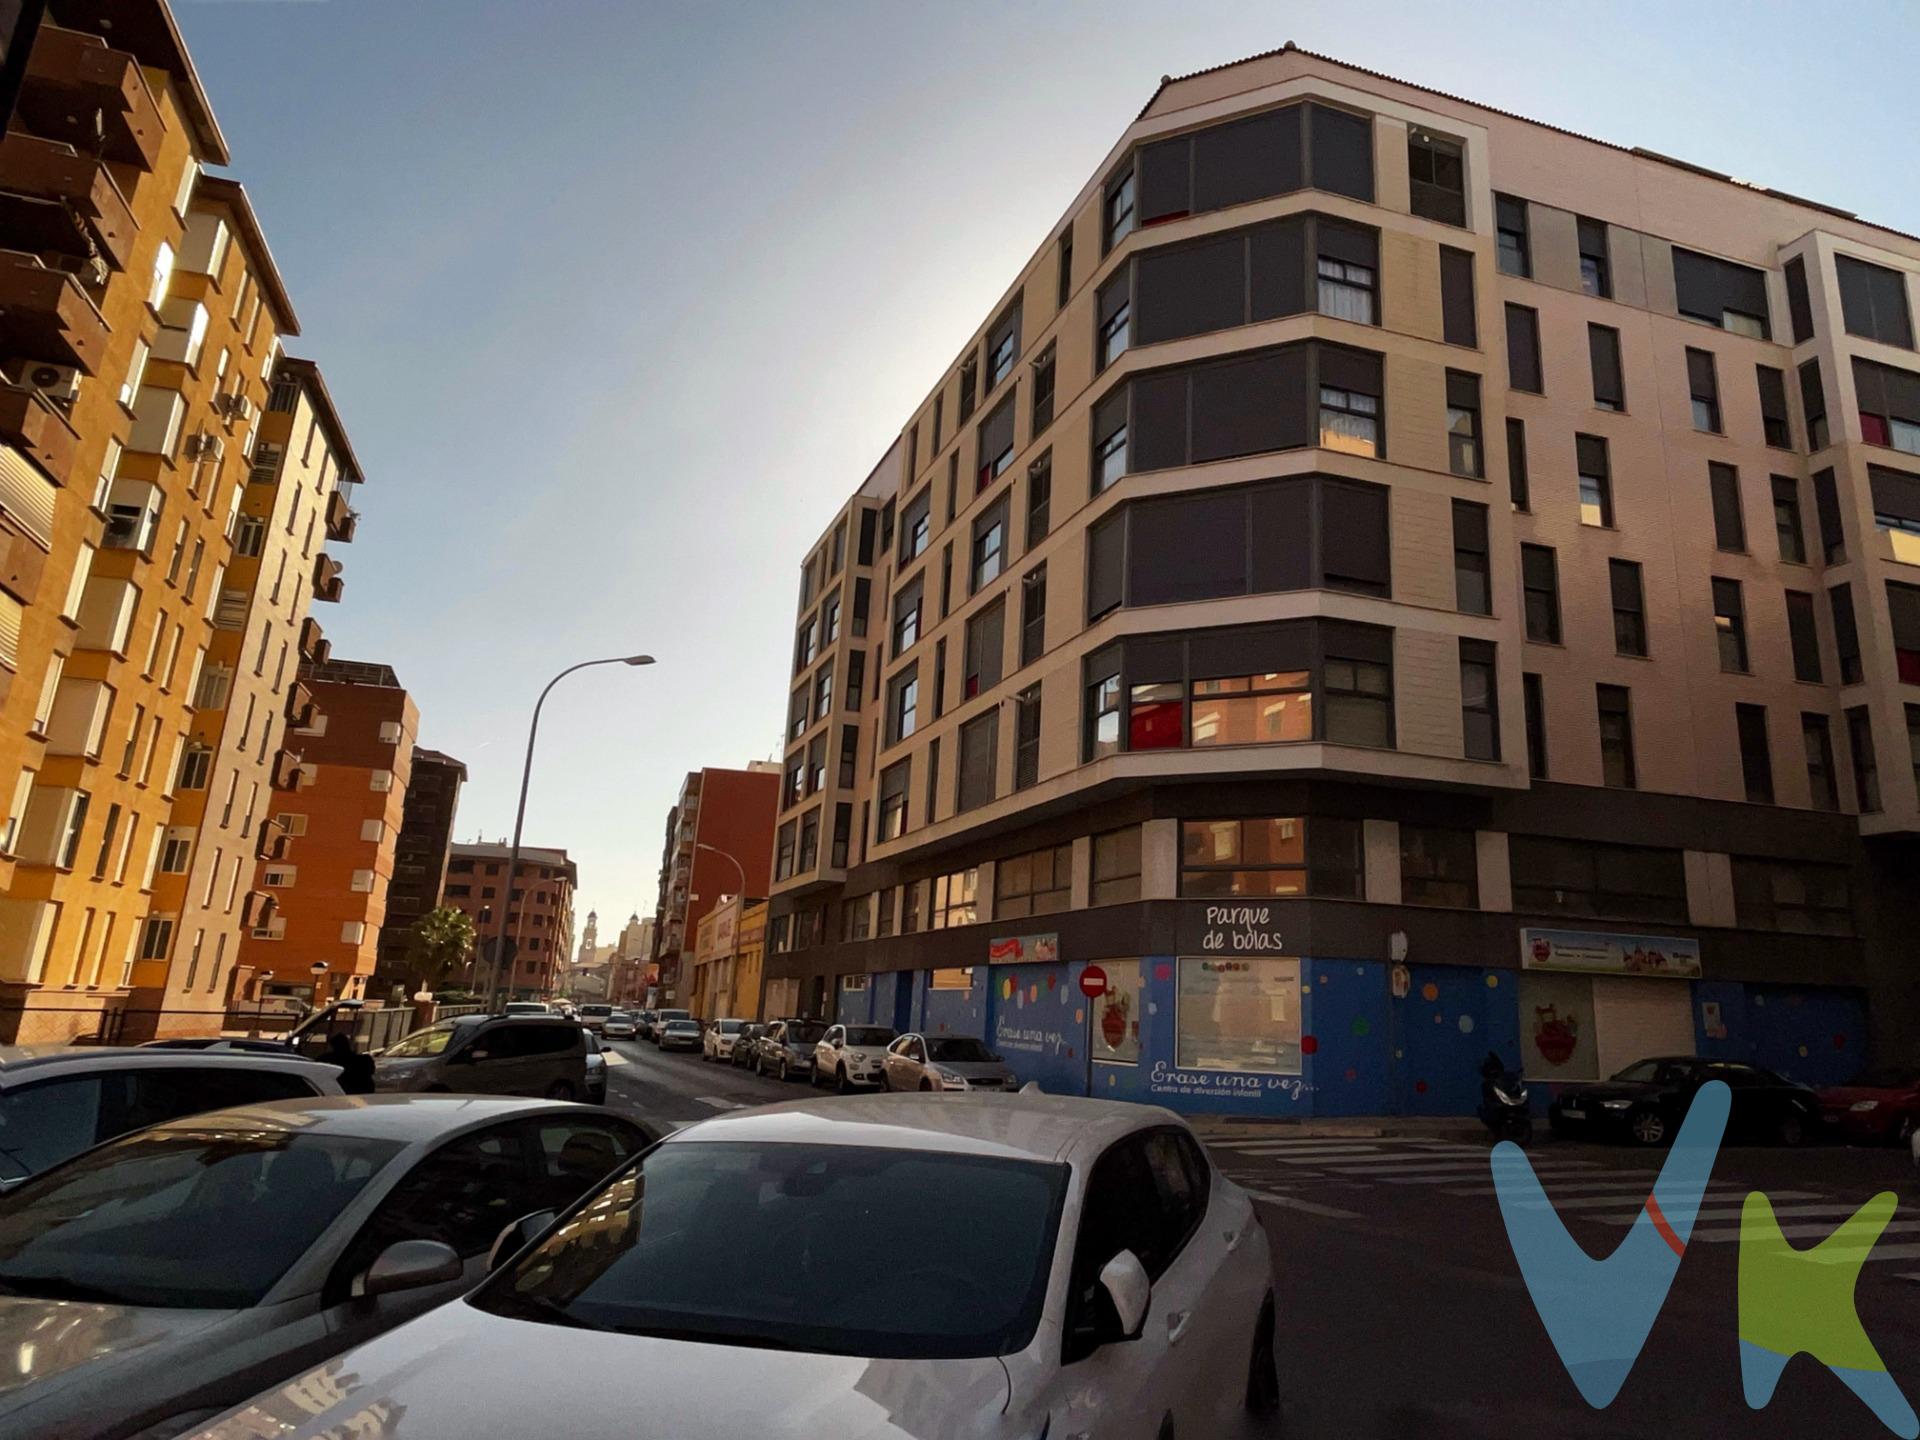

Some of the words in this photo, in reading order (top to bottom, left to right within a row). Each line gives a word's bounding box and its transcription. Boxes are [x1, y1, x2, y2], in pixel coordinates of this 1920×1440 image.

[1206, 906, 1270, 933] Parque
[1203, 929, 1225, 950] de
[1232, 930, 1283, 950] bolas
[1023, 1029, 1043, 1042] una
[1150, 1060, 1211, 1086] Erase
[1216, 1074, 1262, 1088] una
[1151, 1083, 1178, 1093] Centro
[1180, 1085, 1191, 1094] de
[1193, 1086, 1231, 1097] diversión
[1232, 1088, 1262, 1098] infantil
